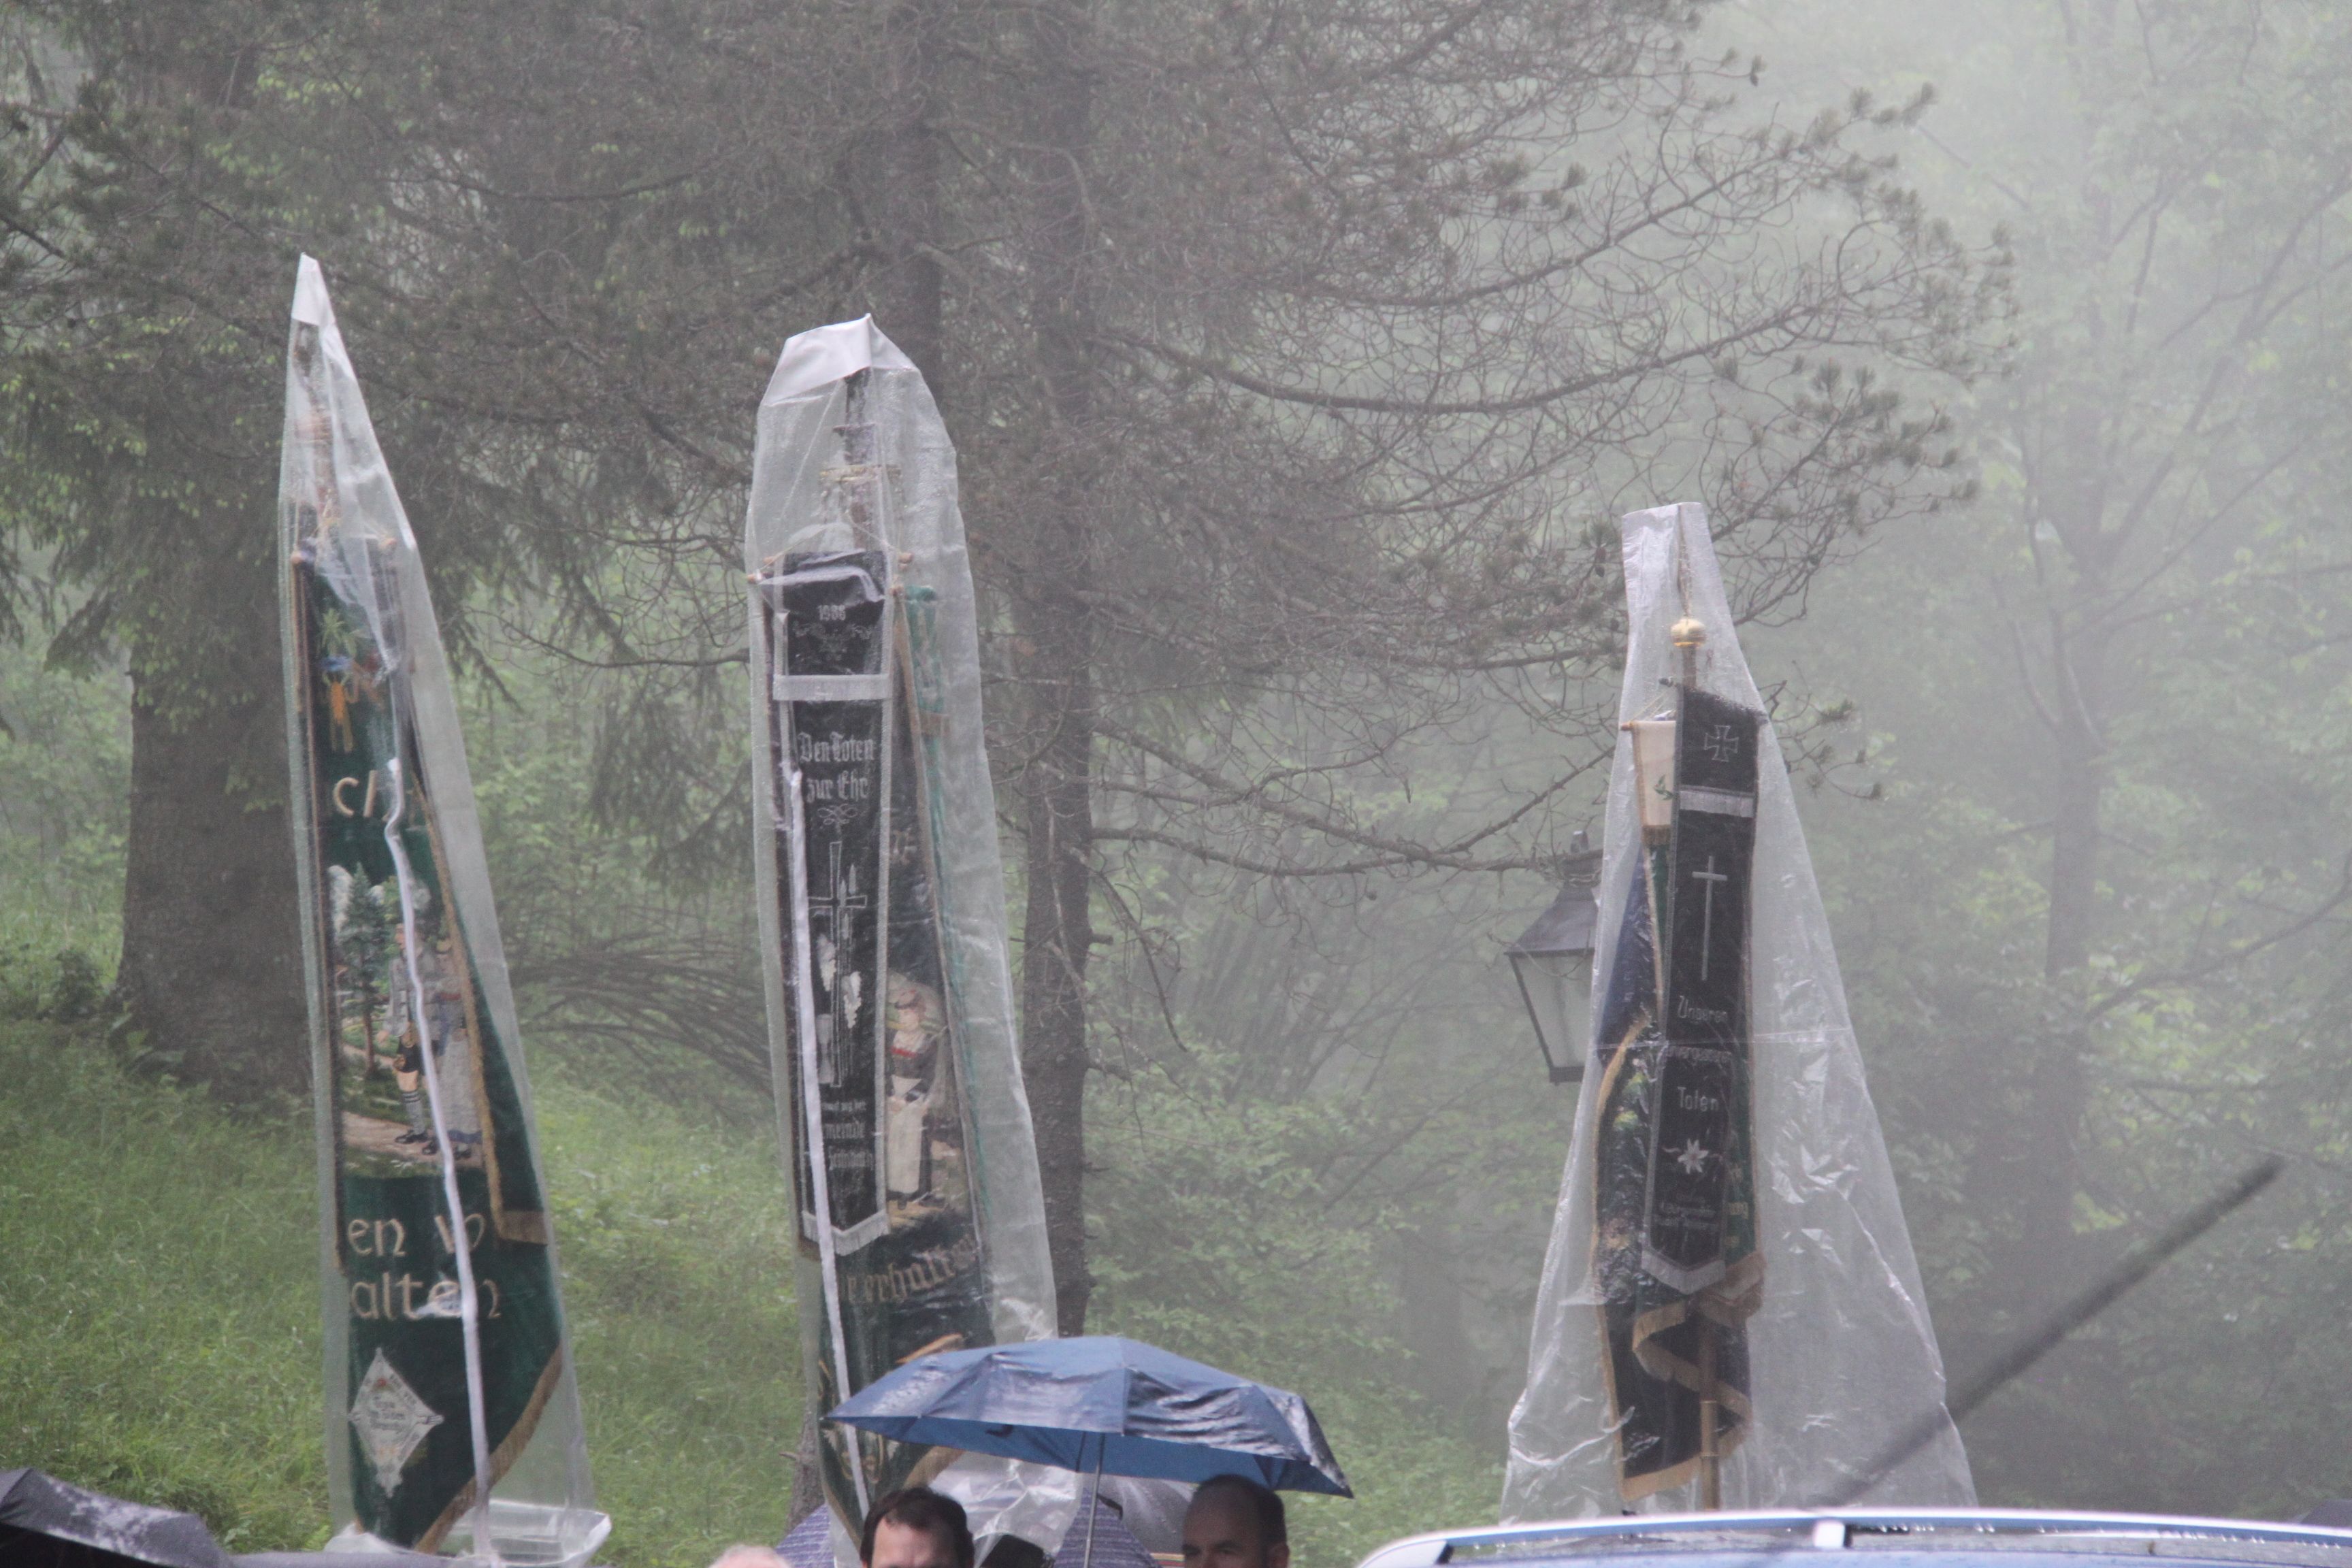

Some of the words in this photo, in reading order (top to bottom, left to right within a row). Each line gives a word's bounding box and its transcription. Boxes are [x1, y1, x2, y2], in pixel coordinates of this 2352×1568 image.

[797, 732, 830, 763] Den
[830, 731, 875, 762] Toten
[806, 778, 834, 804] zur
